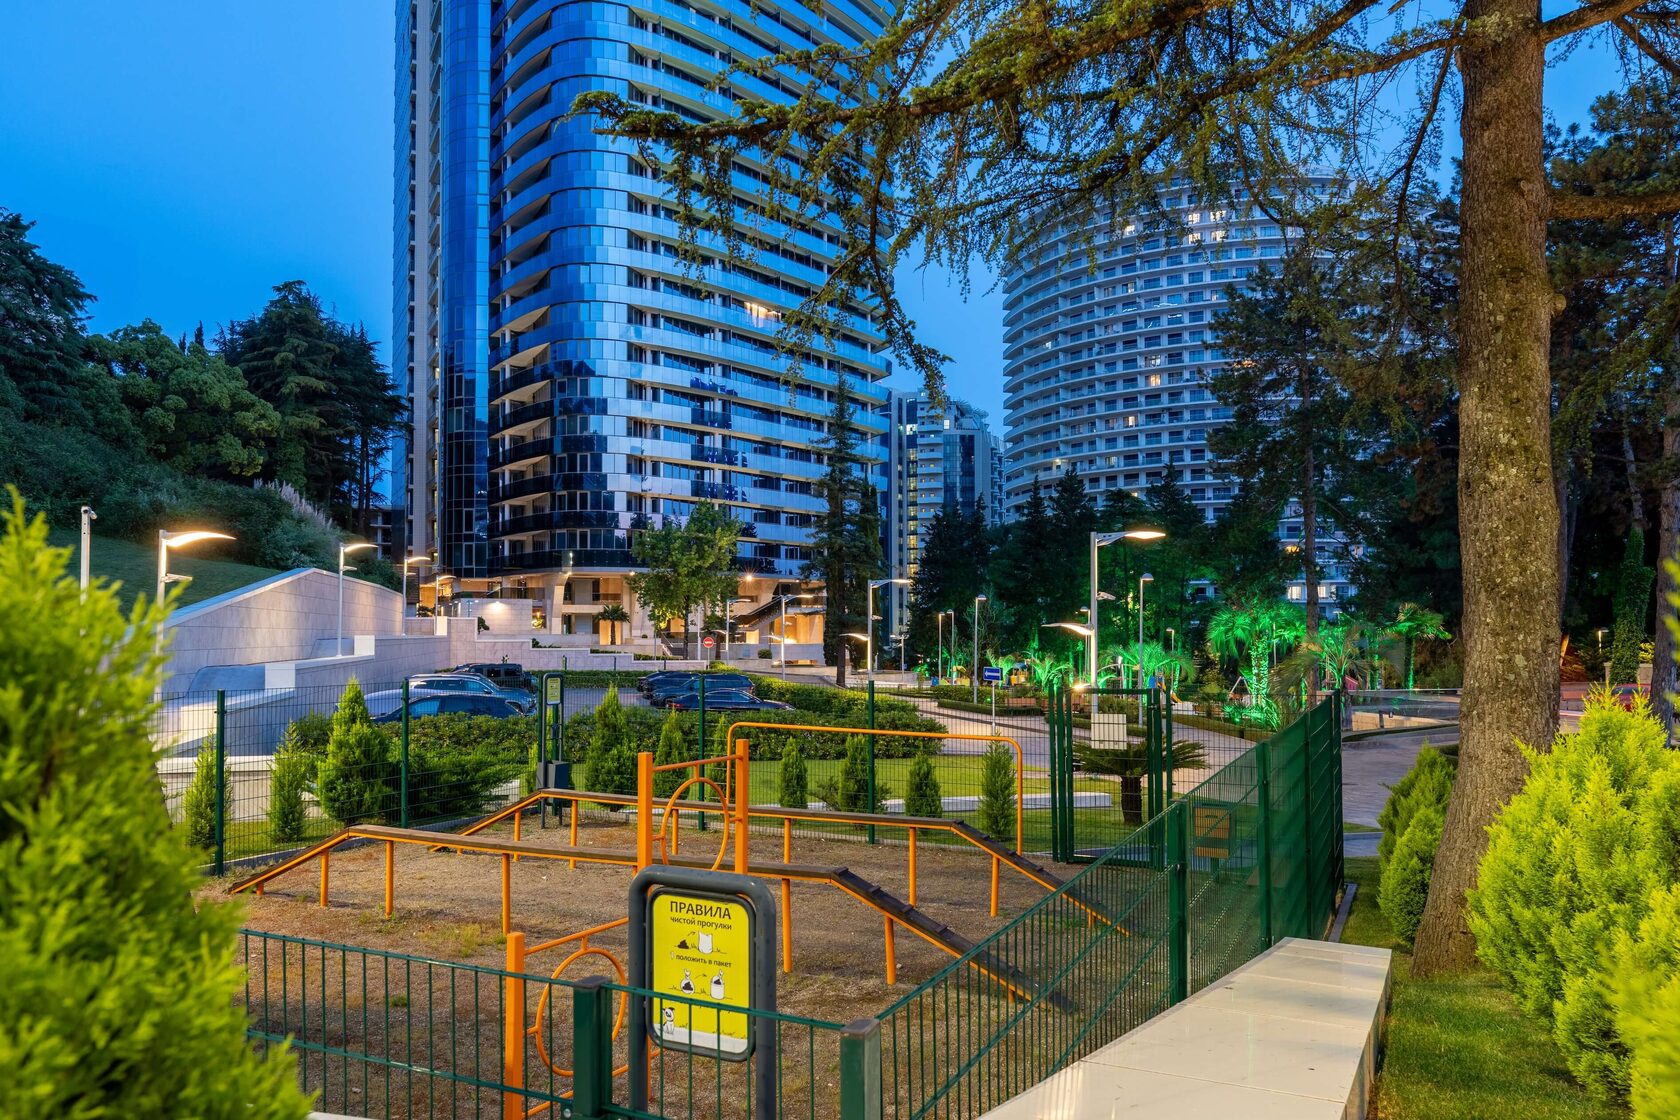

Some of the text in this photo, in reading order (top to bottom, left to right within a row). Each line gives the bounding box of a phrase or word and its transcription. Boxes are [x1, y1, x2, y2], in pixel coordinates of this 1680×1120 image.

[670, 901, 731, 920] ПРАВИЛА
[670, 917, 732, 930] чистой прогулки
[676, 954, 707, 964] положить
[713, 960, 732, 968] пакет
